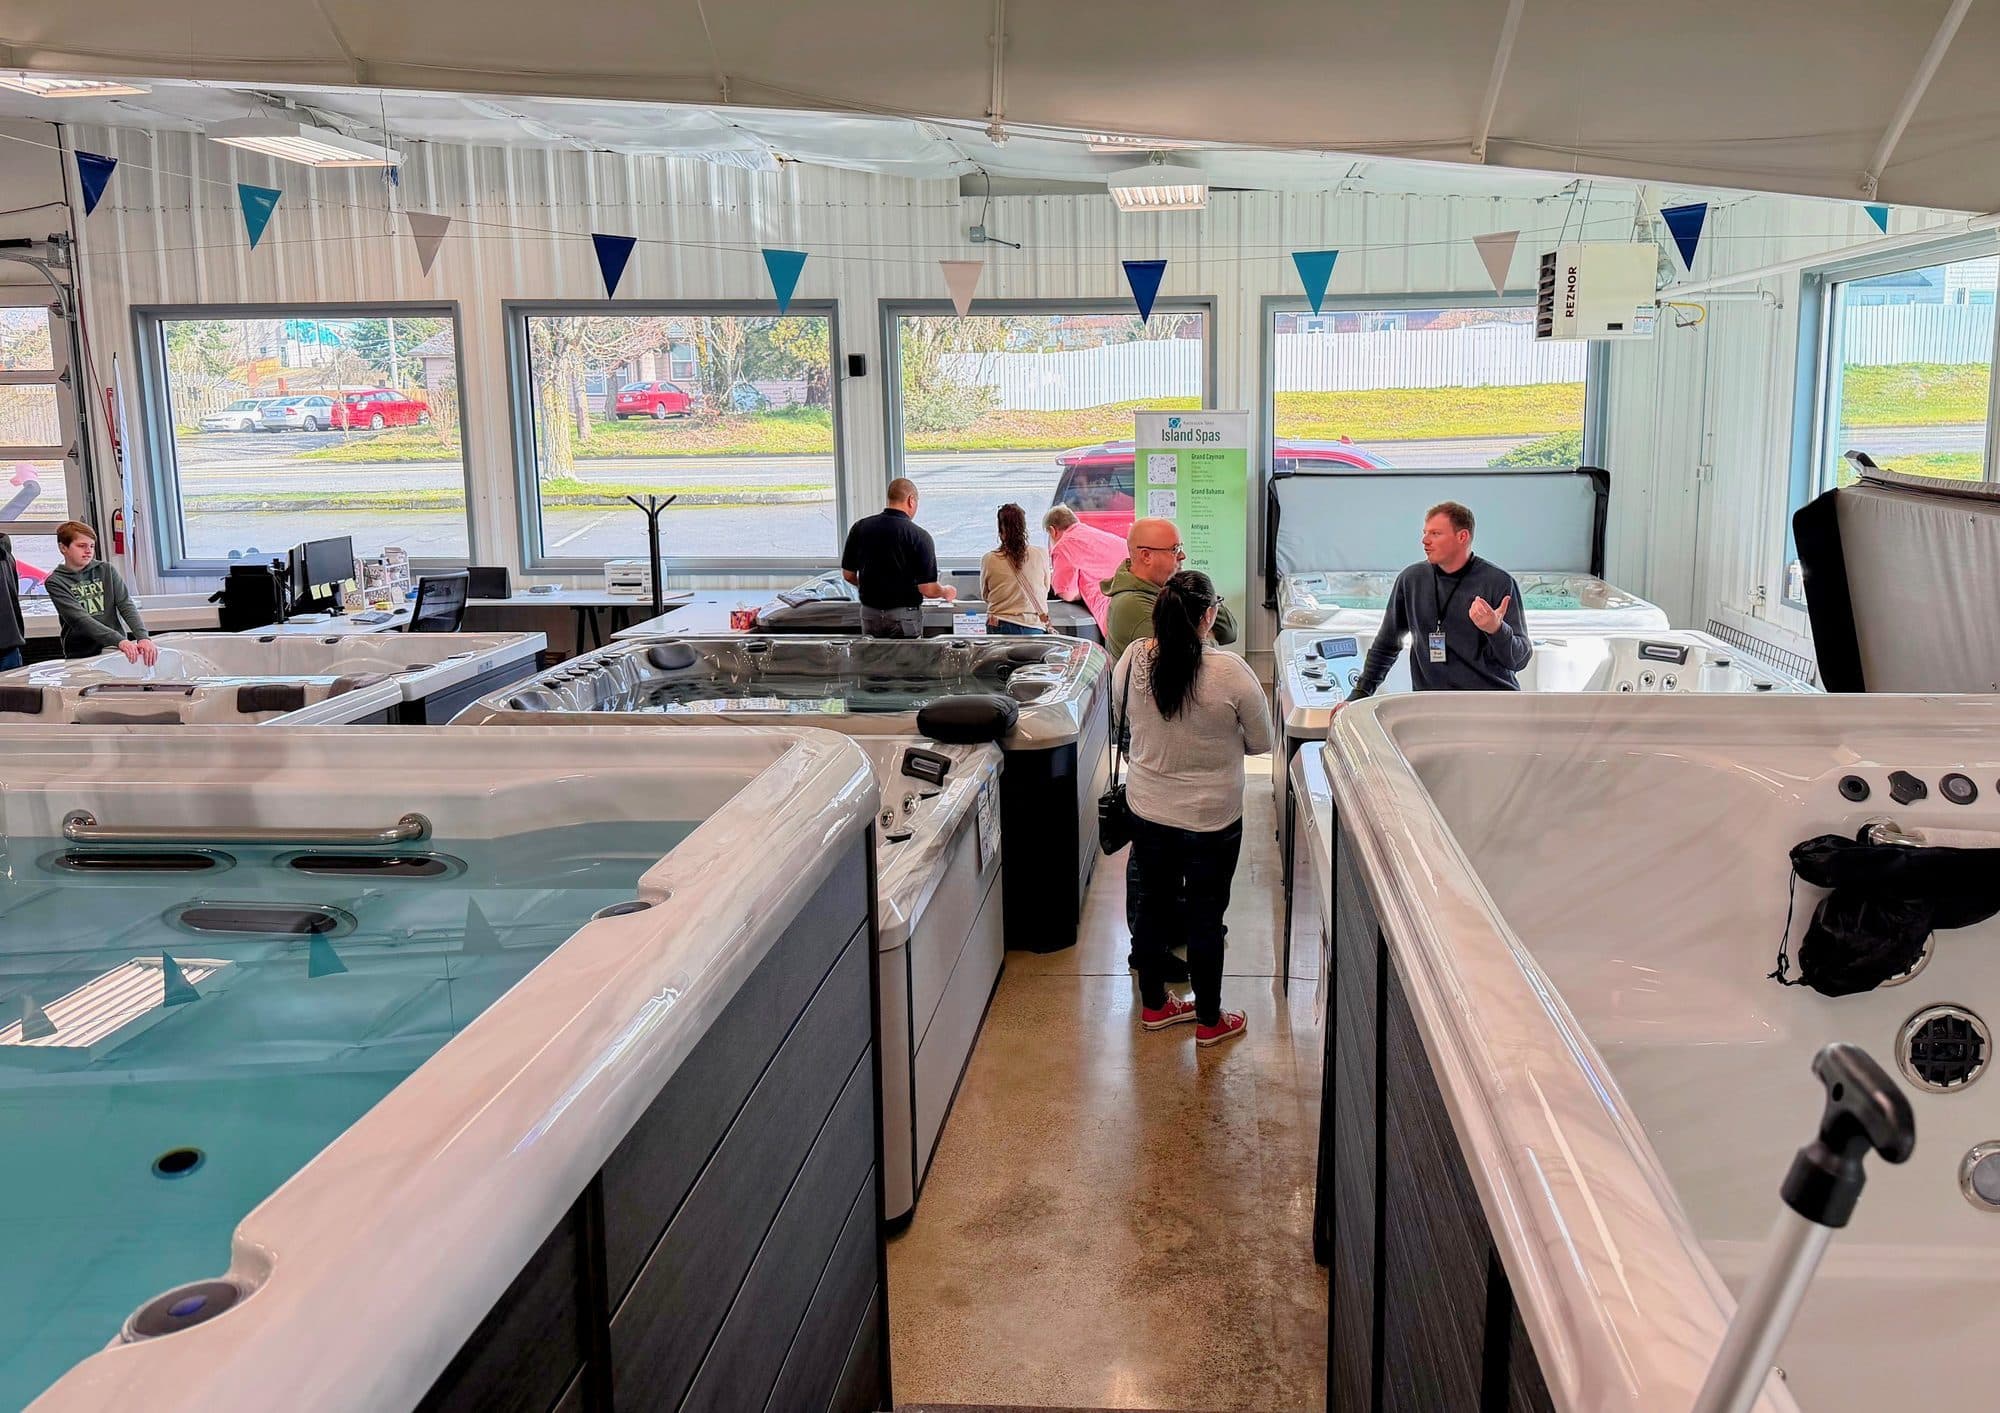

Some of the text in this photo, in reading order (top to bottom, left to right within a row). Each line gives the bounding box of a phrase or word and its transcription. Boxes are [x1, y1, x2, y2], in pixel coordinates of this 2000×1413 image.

[1566, 266, 1577, 318] REZNOR
[1161, 428, 1221, 444] Island Spas
[70, 581, 104, 597] EVERY
[79, 595, 104, 614] DAY
